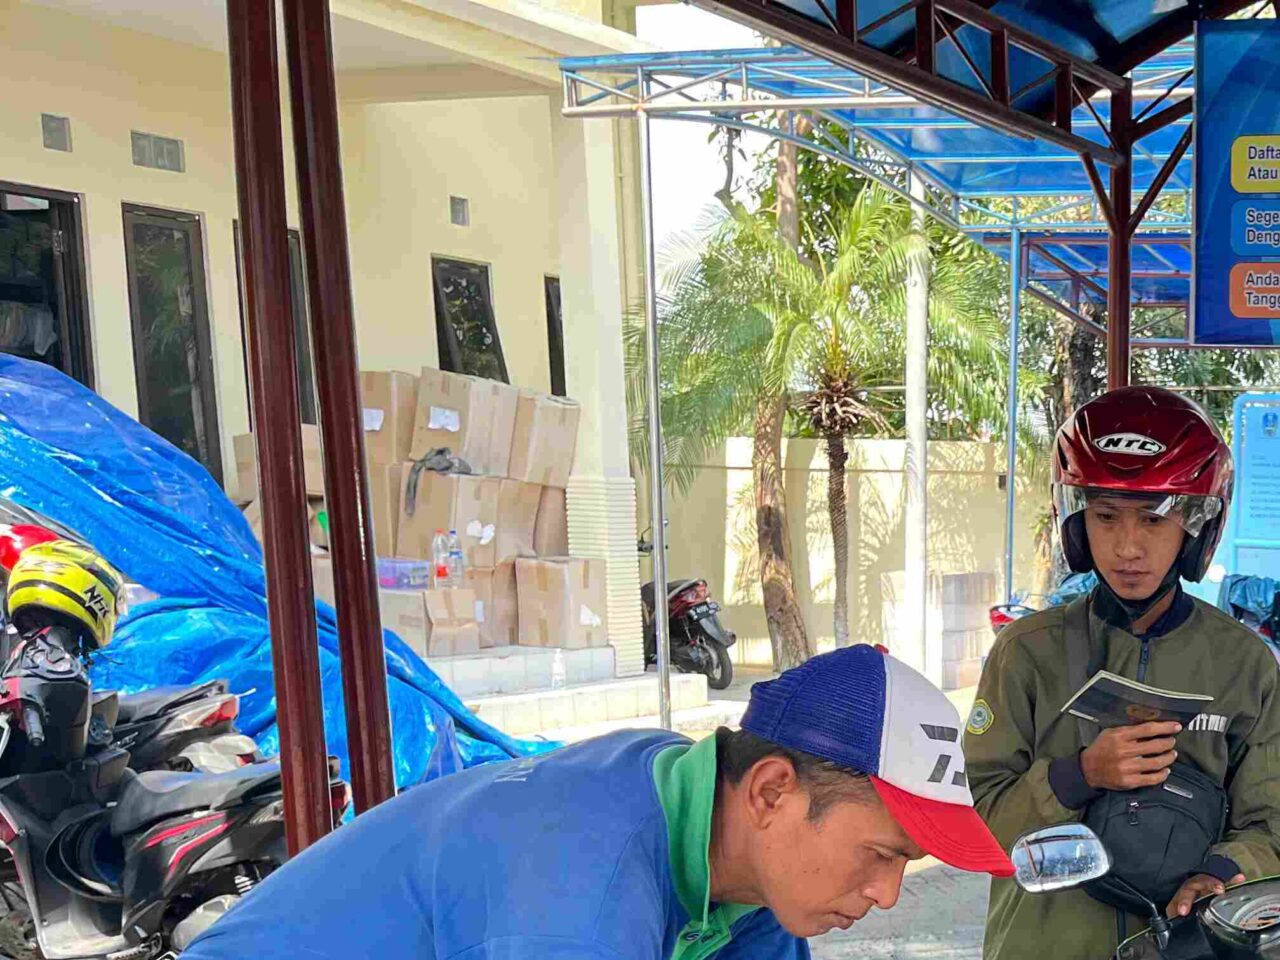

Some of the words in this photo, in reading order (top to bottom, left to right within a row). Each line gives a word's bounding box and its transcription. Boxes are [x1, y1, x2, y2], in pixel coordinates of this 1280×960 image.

[1247, 166, 1278, 179] Atau
[1246, 272, 1280, 286] Anda
[1103, 437, 1158, 452] NTC
